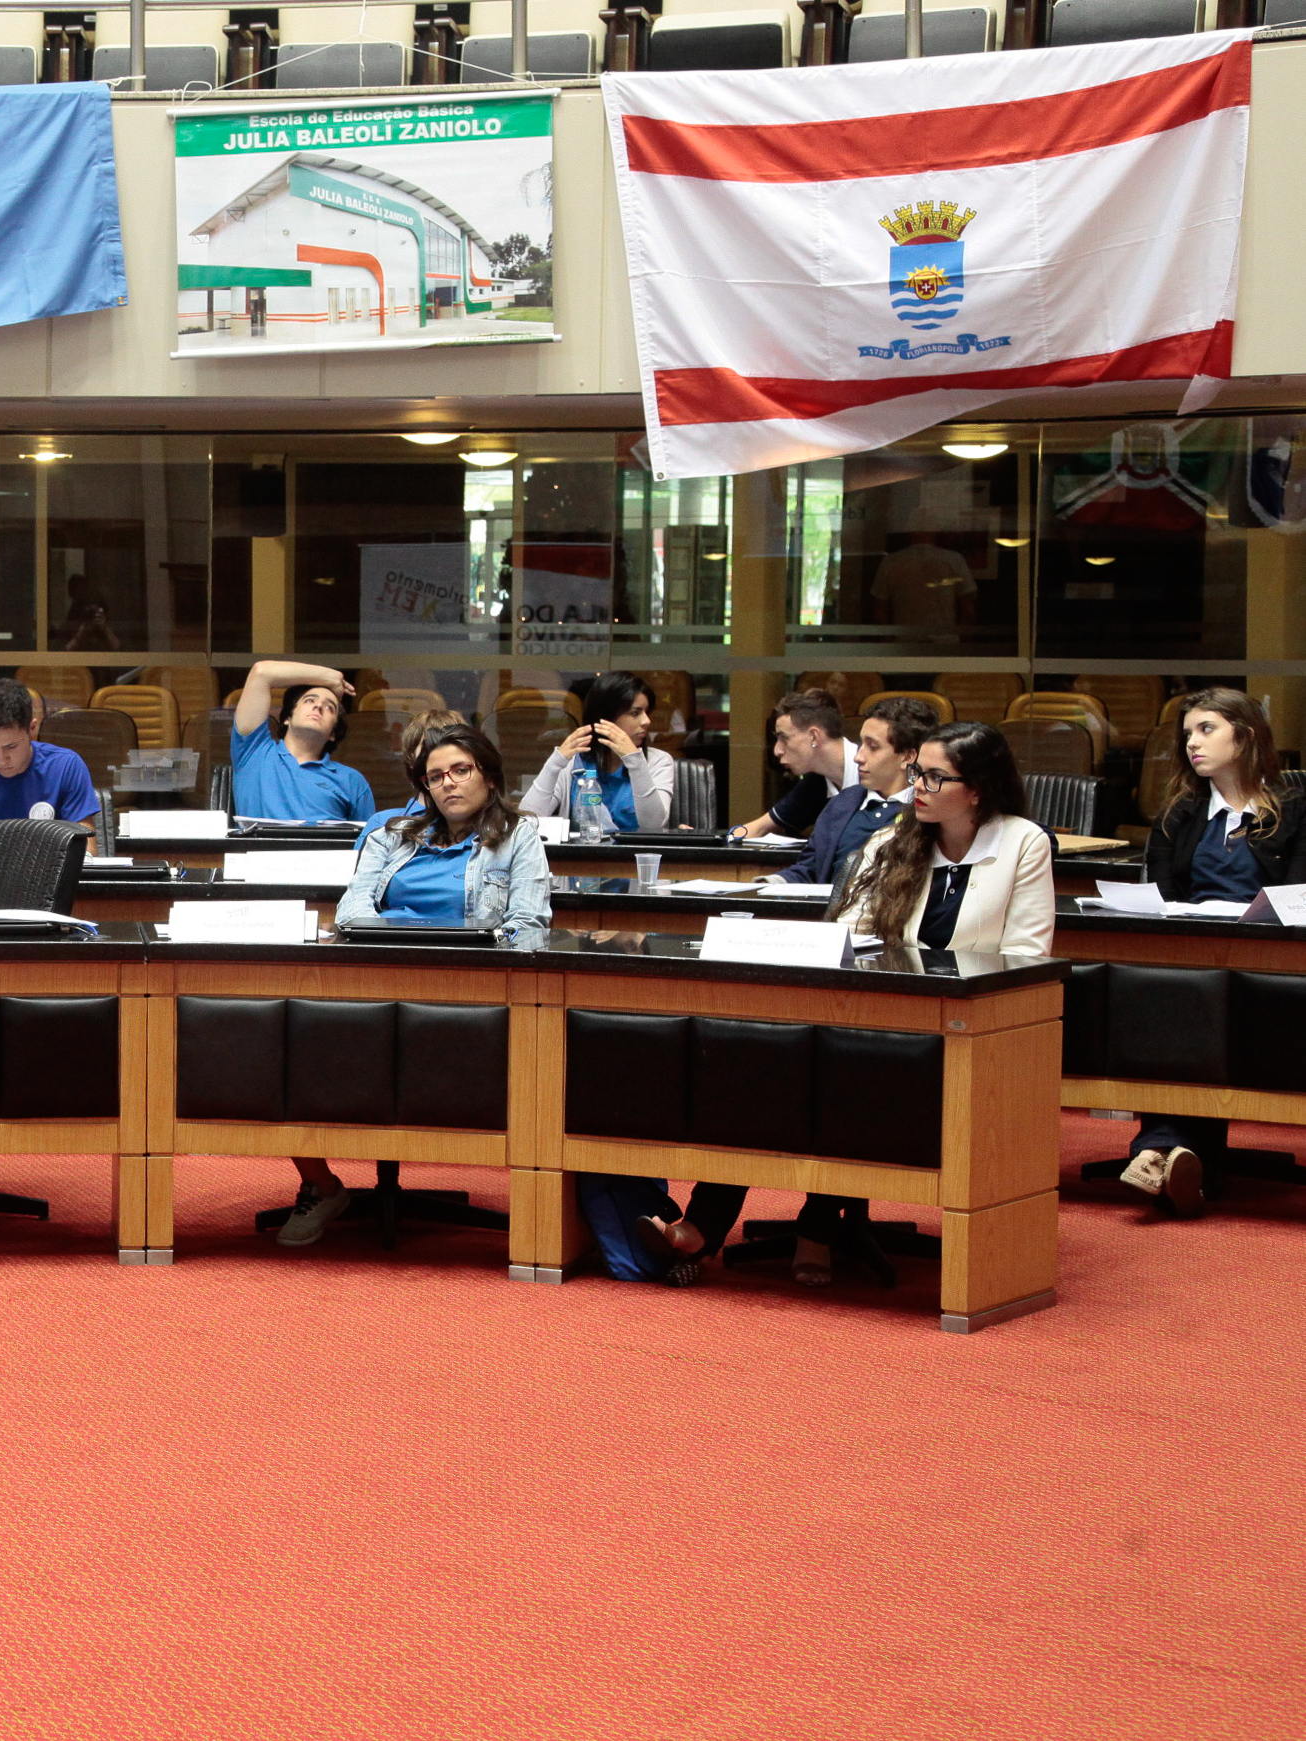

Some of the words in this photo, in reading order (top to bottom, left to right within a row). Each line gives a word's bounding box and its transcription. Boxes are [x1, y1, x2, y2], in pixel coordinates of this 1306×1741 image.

[249, 113, 303, 127] Escola
[307, 112, 328, 124] de
[332, 108, 413, 123] Educação
[417, 104, 474, 117] Básica
[223, 131, 291, 150] JULIA
[296, 124, 392, 146] BALEOLI
[398, 118, 502, 140] ZANIOLO
[309, 186, 344, 206] JULIA
[345, 196, 383, 217] BALEOLI
[383, 208, 414, 226] ZANIOLO
[869, 348, 889, 358] 1726
